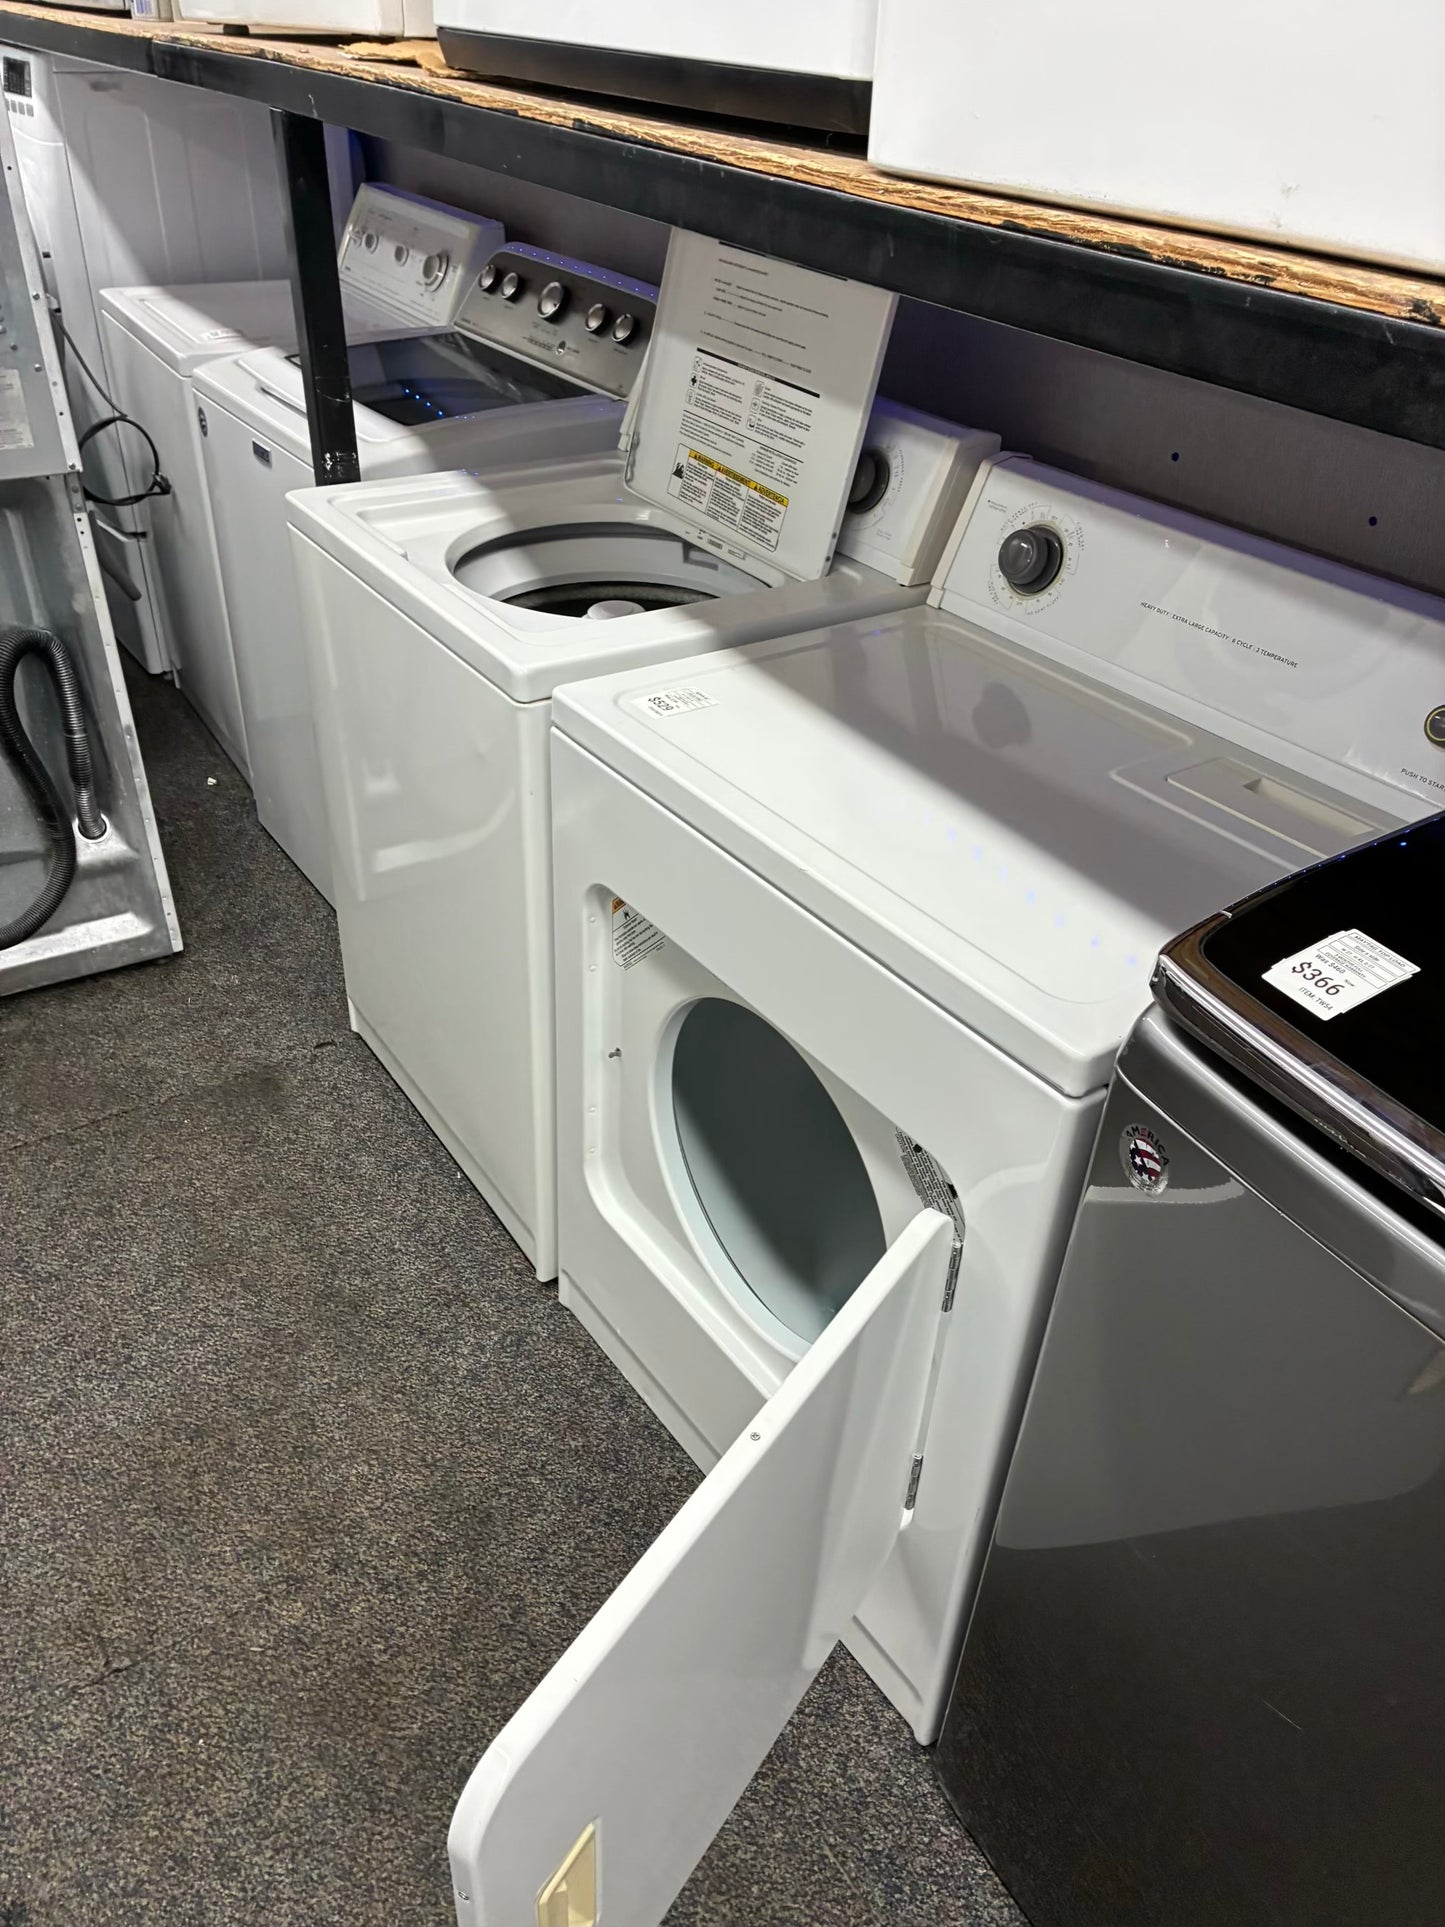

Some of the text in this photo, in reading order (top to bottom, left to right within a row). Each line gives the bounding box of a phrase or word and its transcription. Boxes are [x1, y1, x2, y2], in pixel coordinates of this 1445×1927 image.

[1140, 601, 1156, 612] HEAVY
[1156, 606, 1169, 616] DUTY
[1172, 613, 1188, 624] EXTRA
[1188, 620, 1205, 632] LARGE
[1204, 626, 1230, 641] CAPACITY
[1236, 639, 1253, 651] CYCLE
[1260, 649, 1299, 669] TEMPERATURE
[1400, 767, 1445, 792] PUSH TO STAR
[1315, 953, 1328, 964] Was
[1291, 961, 1345, 996] $366
[1298, 986, 1316, 1001] ITEM:
[1126, 1125, 1170, 1166] AMERICA
